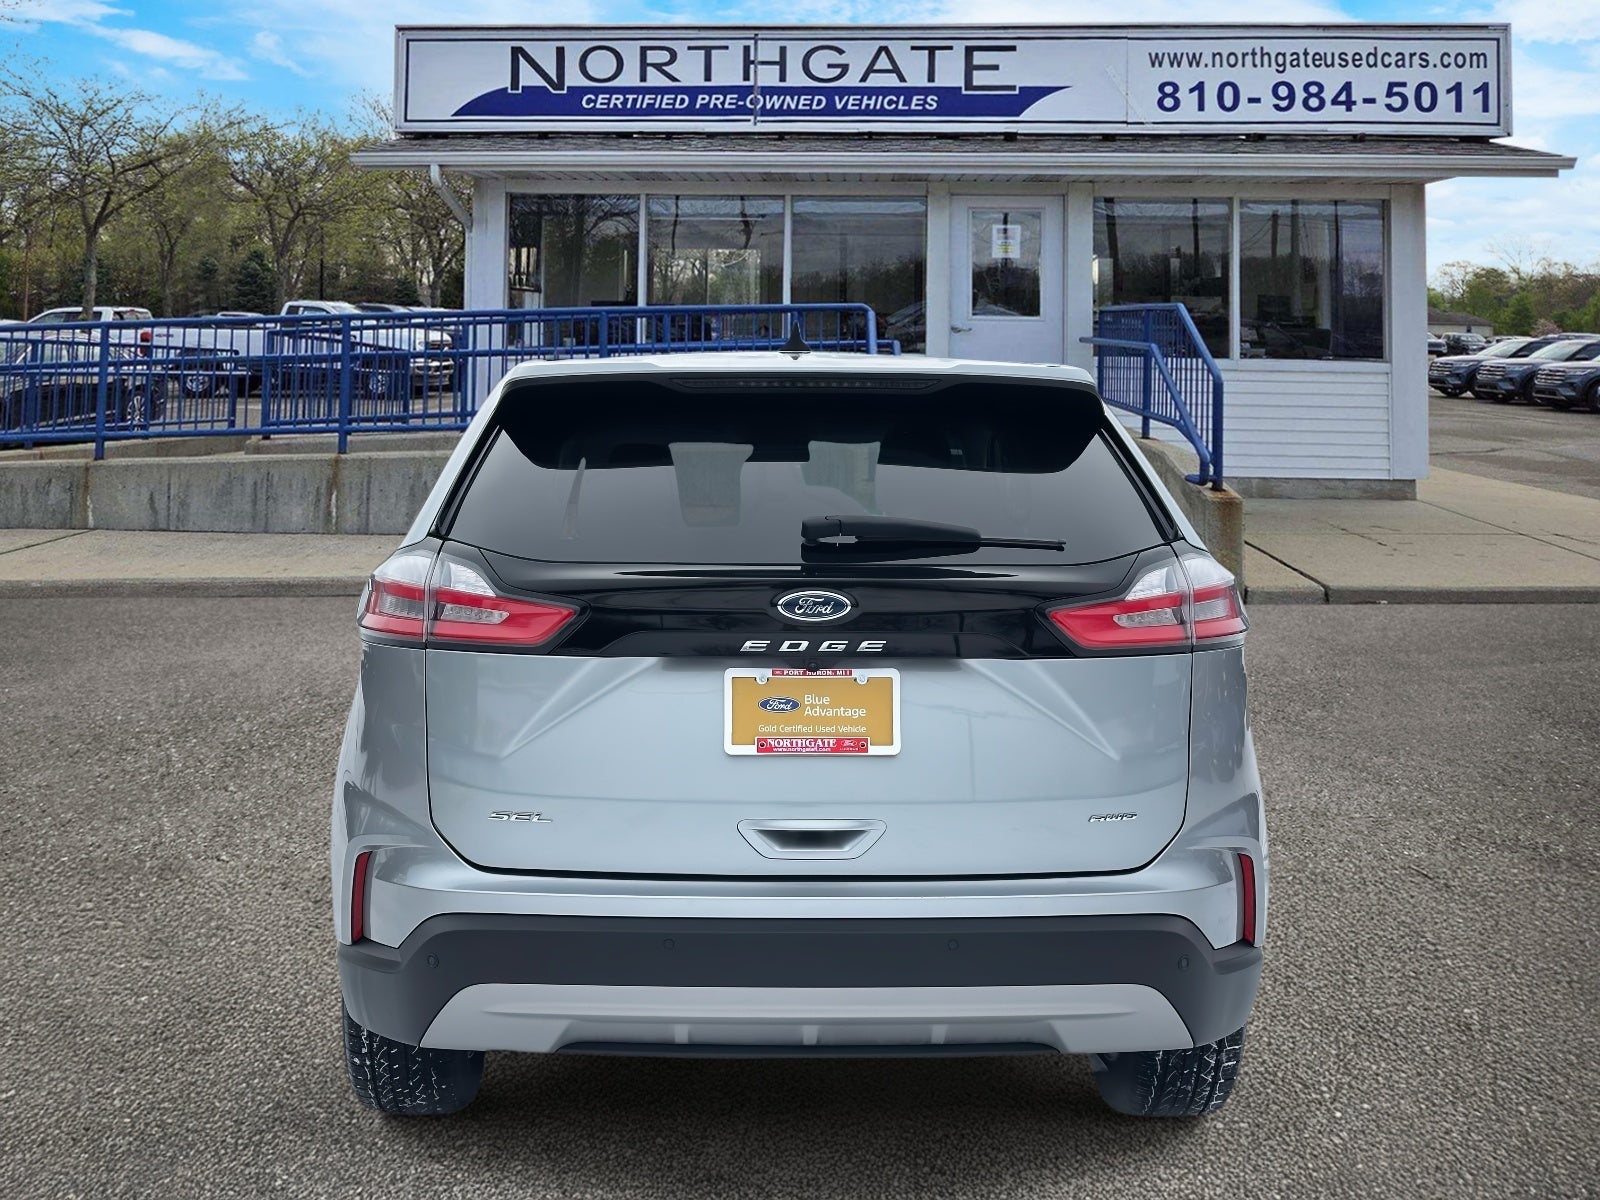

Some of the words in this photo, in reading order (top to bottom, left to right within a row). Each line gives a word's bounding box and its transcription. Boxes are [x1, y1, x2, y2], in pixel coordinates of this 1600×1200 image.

[1148, 46, 1488, 74] www.northgateusedcars.com
[510, 44, 1018, 92] NORTHGATE
[581, 94, 690, 110] CERTIFIED
[694, 94, 827, 111] PRE-OWNED
[834, 94, 939, 111] VEHICLES
[1156, 80, 1491, 114] 810-984-5011
[739, 640, 888, 653] EDGE
[766, 698, 793, 711] Ford
[804, 694, 831, 705] Blue
[804, 706, 867, 719] Advantage
[758, 724, 777, 733] Gold
[779, 724, 813, 733] Certified
[815, 724, 836, 733] Used
[838, 724, 867, 733] Vehicle
[767, 738, 837, 748] NORTHGATE
[487, 810, 553, 823] SEL
